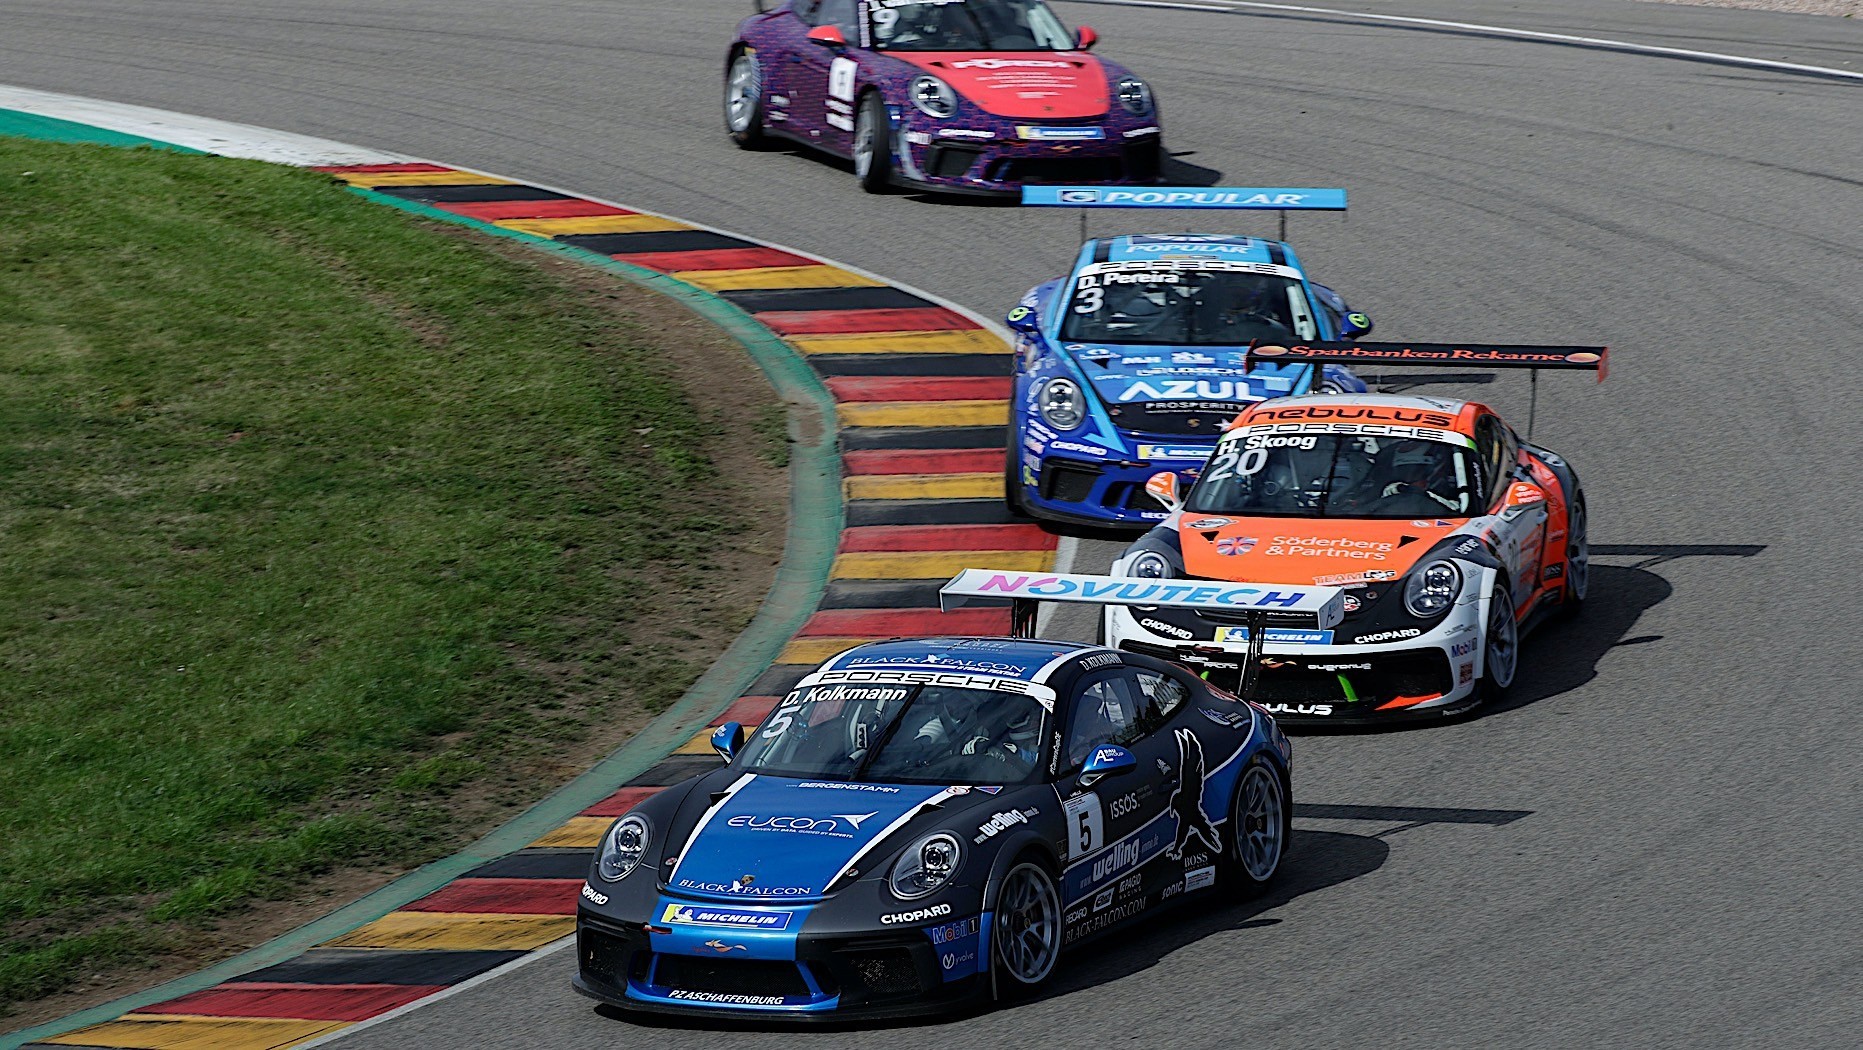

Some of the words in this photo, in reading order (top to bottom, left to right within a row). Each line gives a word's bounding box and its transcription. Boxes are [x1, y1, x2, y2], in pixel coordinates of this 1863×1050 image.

[1103, 191, 1302, 205] POPULAR
[1125, 244, 1248, 254] POPULAR
[1078, 275, 1099, 290] D.
[1103, 271, 1180, 285] Pereira
[1074, 287, 1105, 314] 3
[1288, 345, 1450, 360] Sparbanken
[1451, 350, 1567, 362] Rekarne
[1118, 380, 1268, 401] AZUL
[1145, 402, 1246, 411] PROSPERITY
[1249, 423, 1444, 440] PORSCHE
[1217, 440, 1240, 456] H.
[1245, 435, 1318, 450] Skoog
[1206, 449, 1269, 484] 20
[1270, 536, 1394, 552] Söderberg
[1265, 545, 1285, 556] &
[1287, 545, 1386, 561] Partners
[976, 574, 1306, 608] NOVUTECH
[1140, 618, 1194, 640] CHOPARD
[1255, 633, 1324, 642] ICHELIN
[1354, 628, 1421, 644] CHOPARD
[850, 656, 920, 665] BLACK
[941, 658, 1028, 673] FALCON
[818, 671, 1030, 694] PORSCHE
[780, 690, 800, 708] D.
[803, 685, 907, 704] Kolkmann
[1261, 703, 1334, 716] ULUS
[762, 705, 801, 739] 5
[798, 782, 900, 794] BERGENSTAMM
[727, 815, 837, 831] EUCON
[1078, 810, 1092, 852] 5
[1184, 851, 1209, 868] BOSS
[582, 881, 609, 905] OPARD
[678, 878, 729, 893] BLACK
[742, 885, 812, 896] FALCON
[695, 910, 779, 925] MICHELIN
[880, 903, 952, 925] CHOPARD
[1066, 906, 1088, 926] RECARO
[932, 920, 968, 945] Mobil
[667, 989, 688, 999] PZ
[684, 990, 785, 1005] ASCHAFFENBURG
